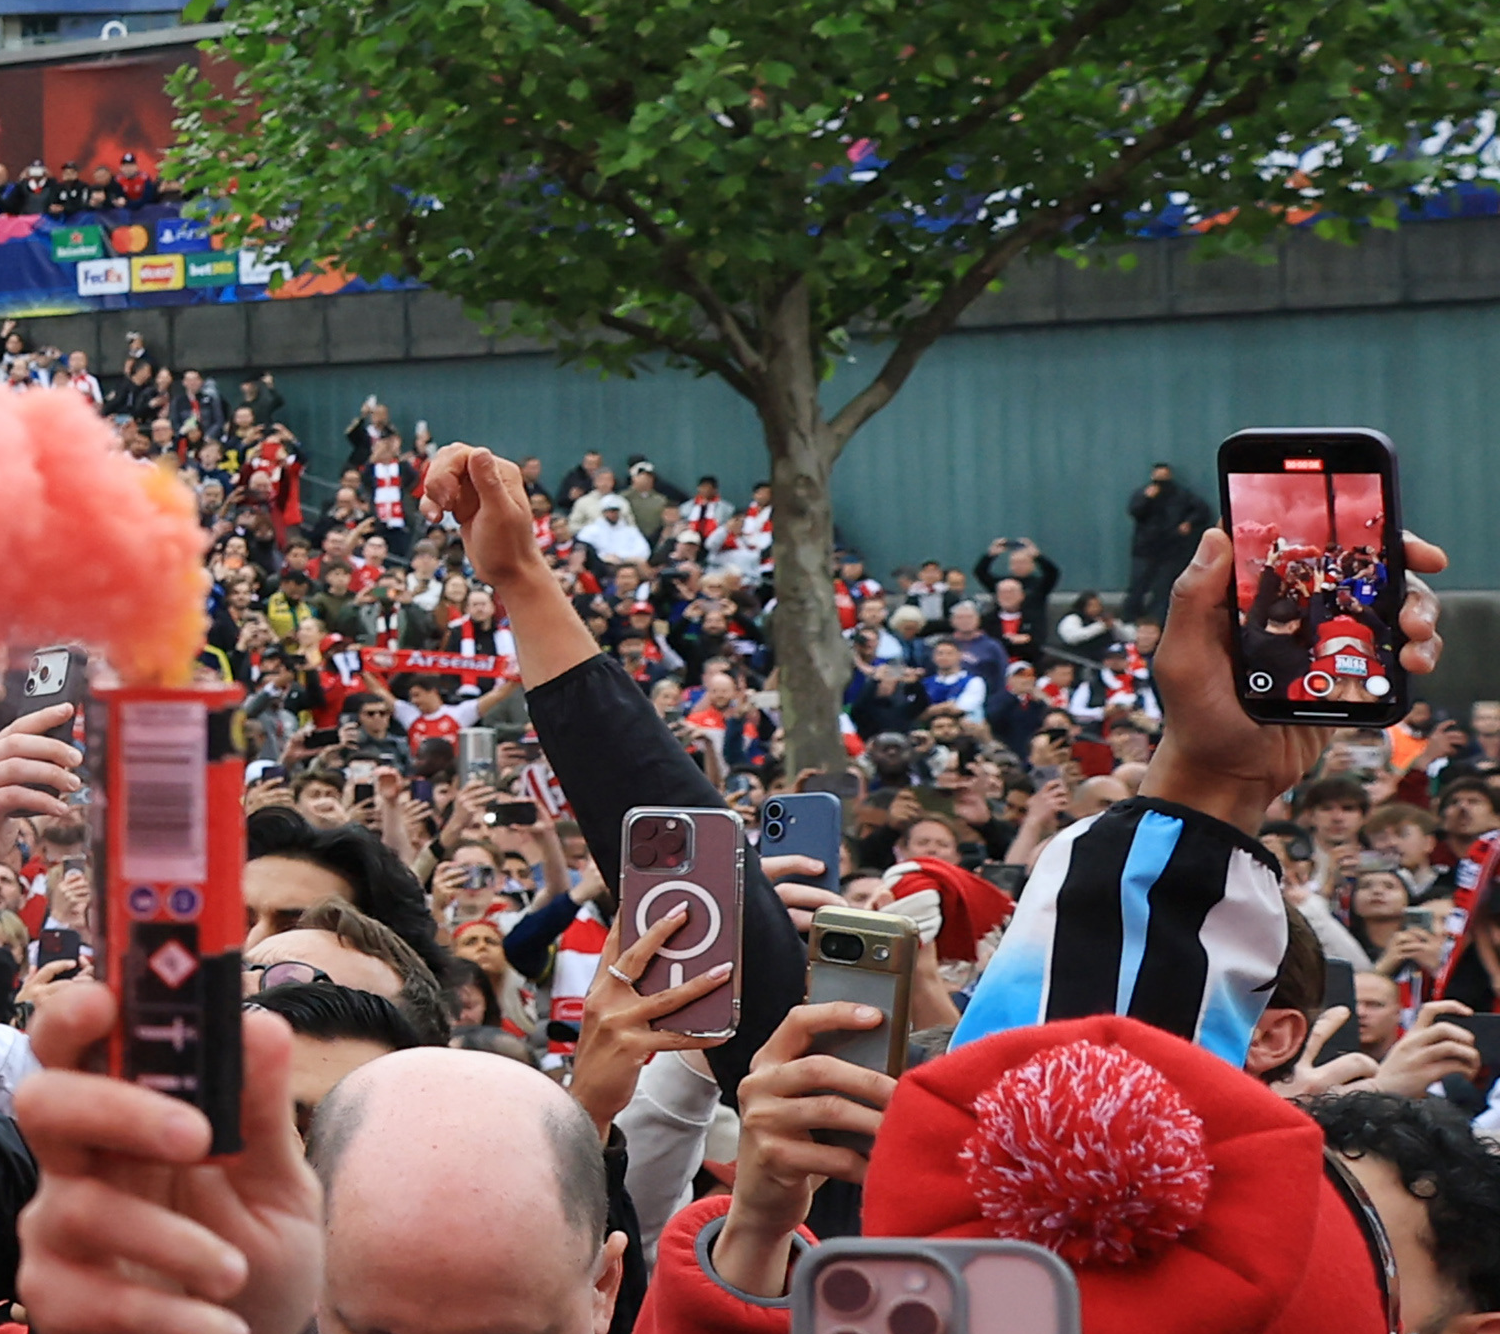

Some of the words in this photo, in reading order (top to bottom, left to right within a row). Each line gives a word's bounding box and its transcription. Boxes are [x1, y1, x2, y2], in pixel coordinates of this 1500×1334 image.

[84, 267, 123, 285] FedEx
[188, 260, 235, 278] bet365
[405, 650, 496, 671] Arsenal
